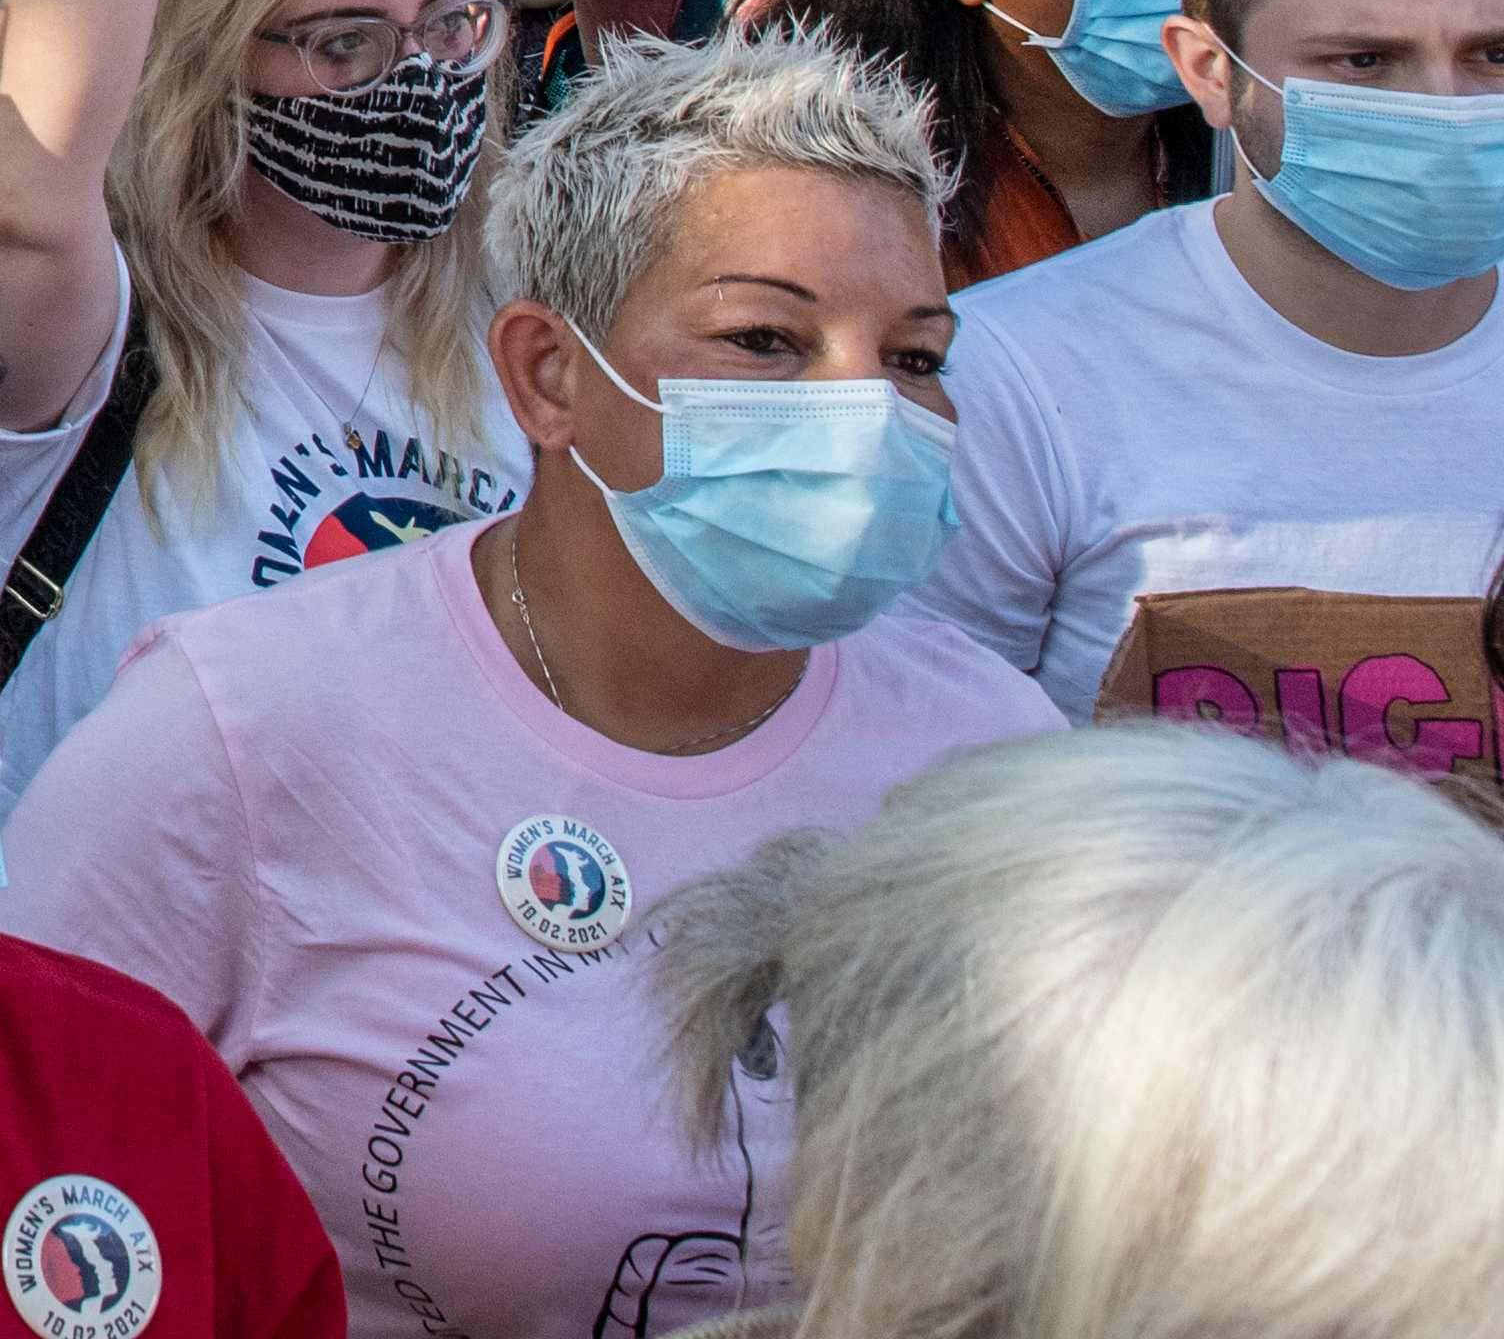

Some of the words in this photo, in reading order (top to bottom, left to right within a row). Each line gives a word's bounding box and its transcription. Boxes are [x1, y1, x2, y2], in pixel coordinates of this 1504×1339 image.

[506, 819, 554, 879] WOMEN'S
[563, 820, 617, 866] MARCH
[610, 875, 627, 911] ATX
[516, 898, 608, 944] 10.02.2021
[521, 948, 576, 984] IN
[361, 963, 527, 1195] GOVERNMENT
[15, 1195, 55, 1294] WOMEN'S
[61, 1184, 131, 1224] MARCH
[129, 1229, 155, 1274] ATX
[363, 1197, 412, 1271] THE
